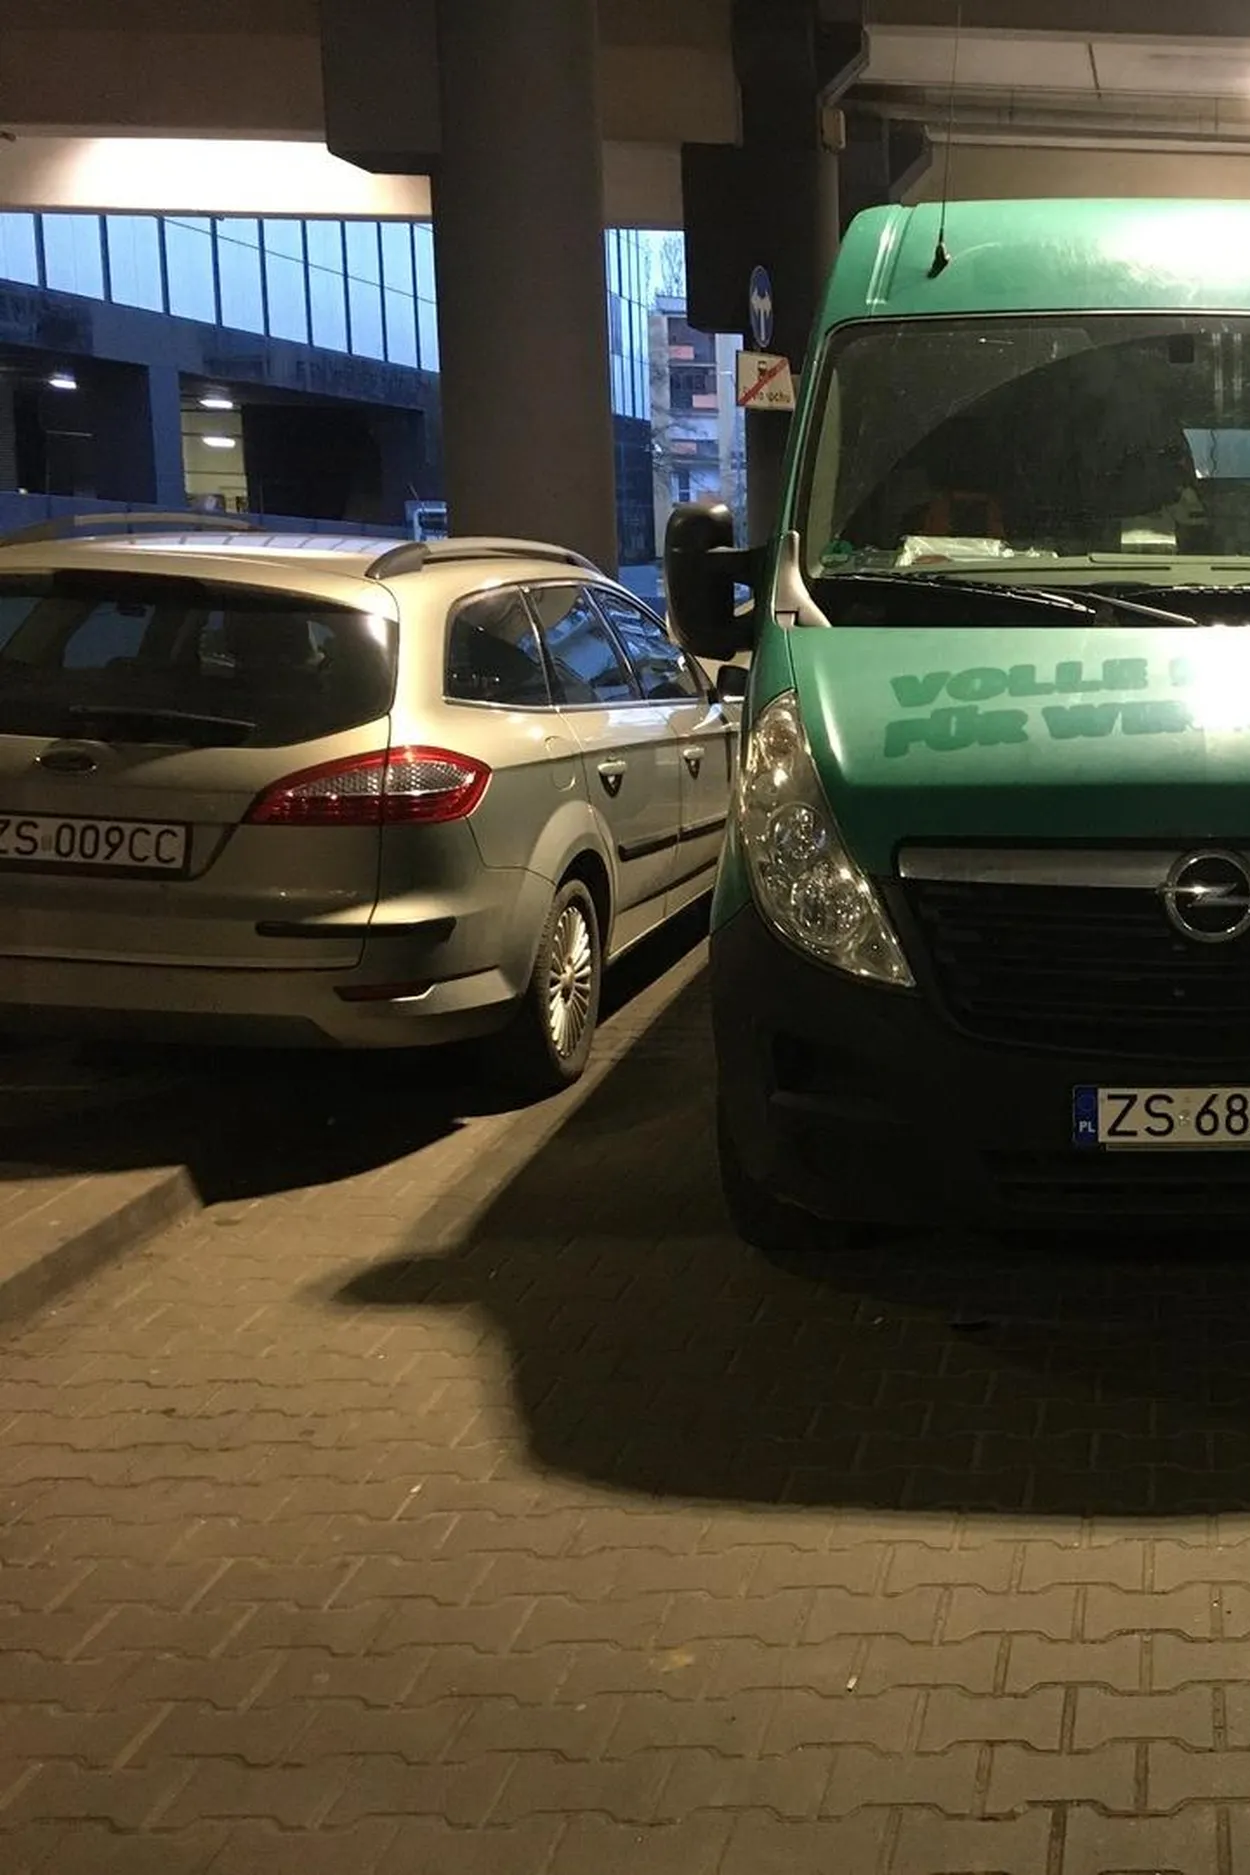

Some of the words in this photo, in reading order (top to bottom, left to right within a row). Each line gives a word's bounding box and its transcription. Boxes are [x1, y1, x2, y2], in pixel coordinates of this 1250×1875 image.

[890, 657, 1149, 707] VOLLE
[884, 704, 1029, 758] FÜR
[54, 822, 179, 864] 009CC
[1078, 1120, 1097, 1133] PL
[1106, 1093, 1175, 1137] ZS
